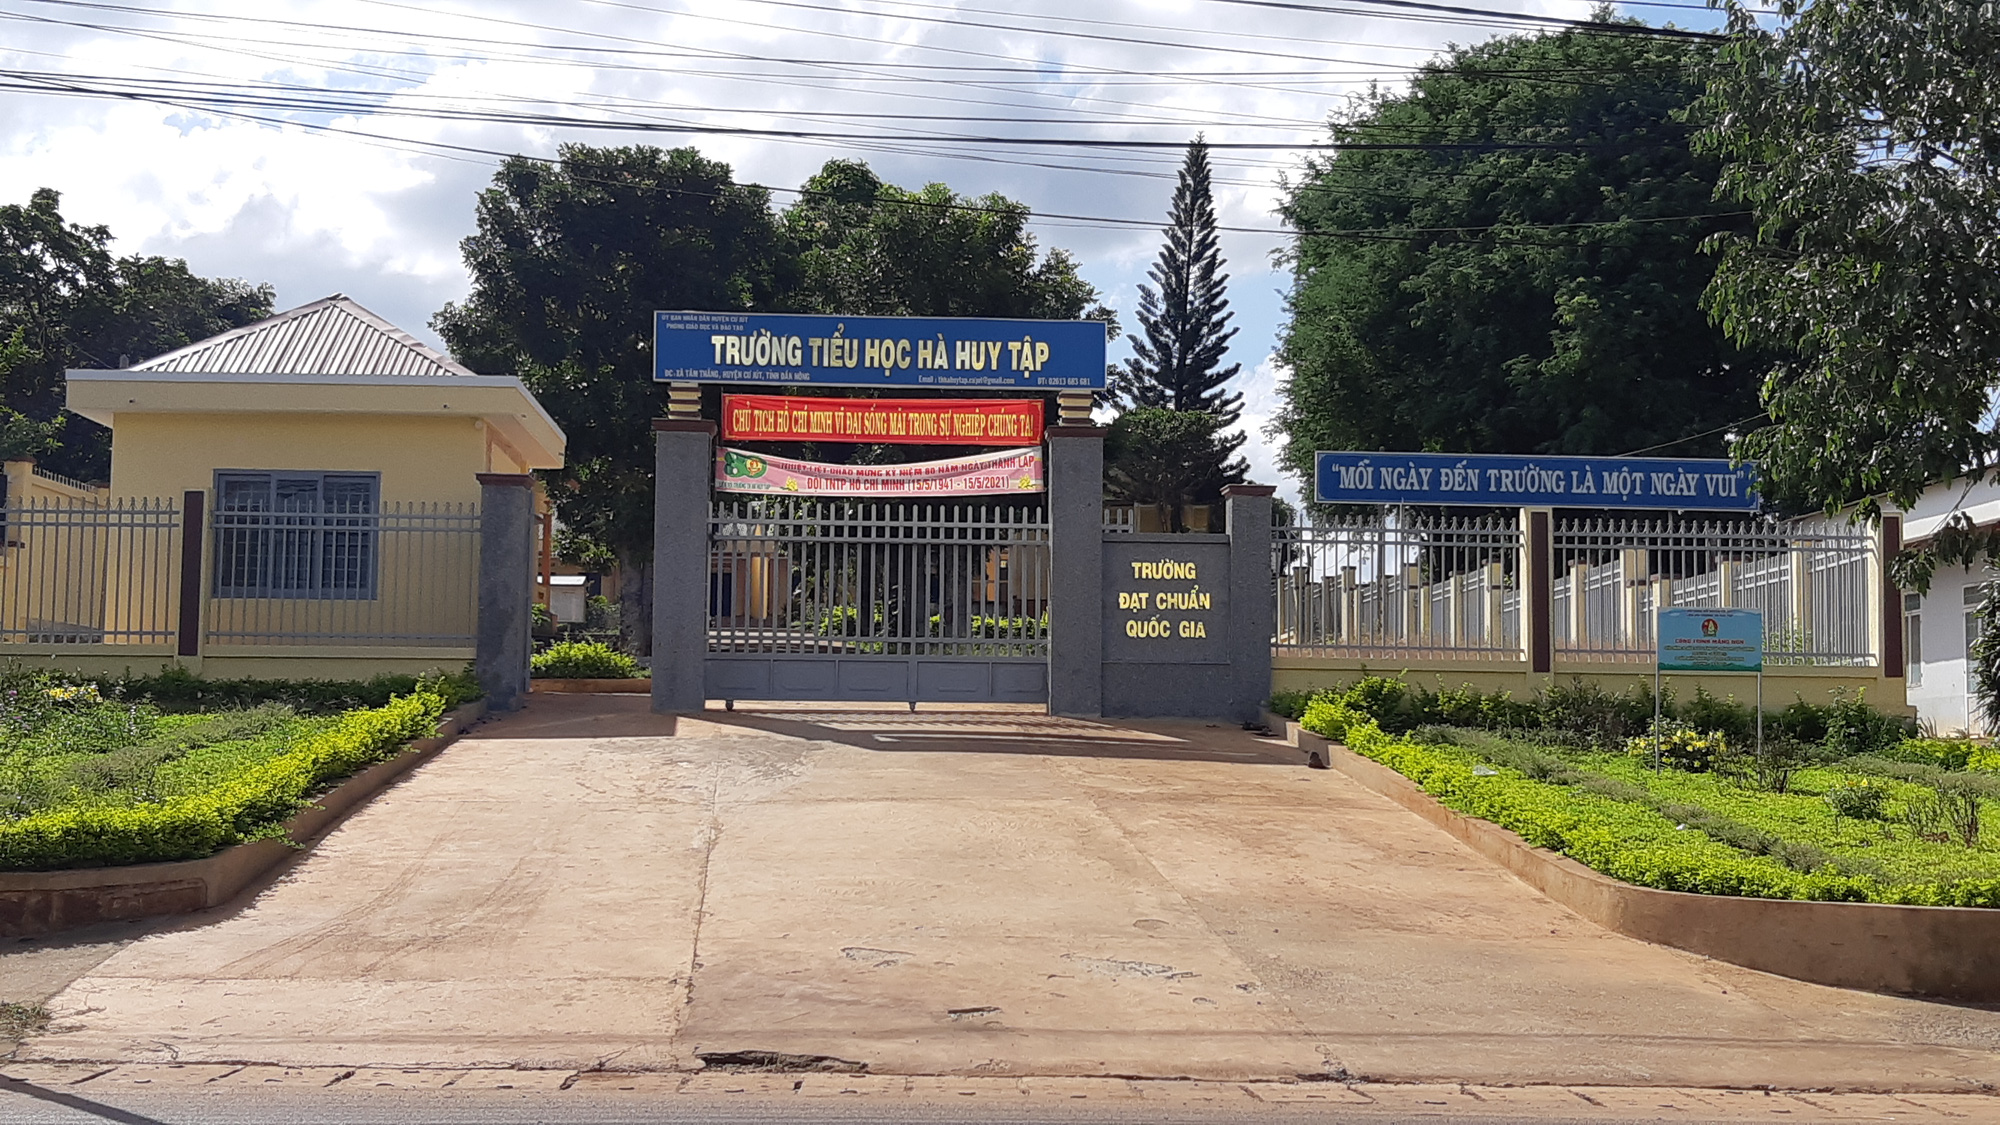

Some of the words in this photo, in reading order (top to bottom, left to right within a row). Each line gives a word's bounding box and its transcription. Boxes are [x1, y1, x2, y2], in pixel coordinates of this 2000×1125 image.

[711, 328, 802, 366] TRƯỜNG
[808, 323, 858, 368] TIỂU
[864, 339, 911, 376] HỌC
[918, 333, 949, 369] HÀ
[955, 340, 1002, 370] HUY
[1008, 335, 1049, 378] TẬP
[733, 401, 751, 432] CHỦ
[753, 410, 774, 436] TỊCH
[777, 401, 789, 432] HỒ
[792, 405, 808, 433] CHÍ
[810, 412, 832, 433] MINH
[835, 406, 844, 434] VĨ
[846, 412, 862, 439] ĐẠI
[864, 403, 887, 435] SỐNG
[889, 407, 906, 436] MÃI
[908, 413, 937, 436] TRONG
[939, 410, 952, 440] SỰ
[953, 408, 986, 441] NGHIỆP
[987, 408, 1017, 437] CHÚNG
[1019, 414, 1034, 437] TA!
[938, 463, 959, 474] NĂM
[1018, 455, 1035, 471] LẬP
[807, 475, 822, 492] ĐỘI
[825, 478, 846, 491] TNTP
[850, 475, 861, 491] HỒ
[864, 476, 878, 491] CHÍ
[881, 479, 905, 491] MINH
[908, 477, 953, 491] (15/5/1941
[963, 476, 1010, 490] 15/5/2021)
[1379, 461, 1433, 490] NGÀY
[1440, 460, 1480, 491] ĐẾN
[1486, 463, 1565, 493] TRƯỜNG
[1571, 465, 1596, 493] LÀ
[1602, 466, 1645, 501] MỘT
[1650, 467, 1699, 496] NGÀY
[1131, 558, 1196, 580] TRƯỜNG
[1119, 592, 1149, 613] ĐẠT
[1156, 584, 1211, 609] CHUẨN
[1126, 614, 1171, 638] QUỐC
[1179, 621, 1207, 638] GIA
